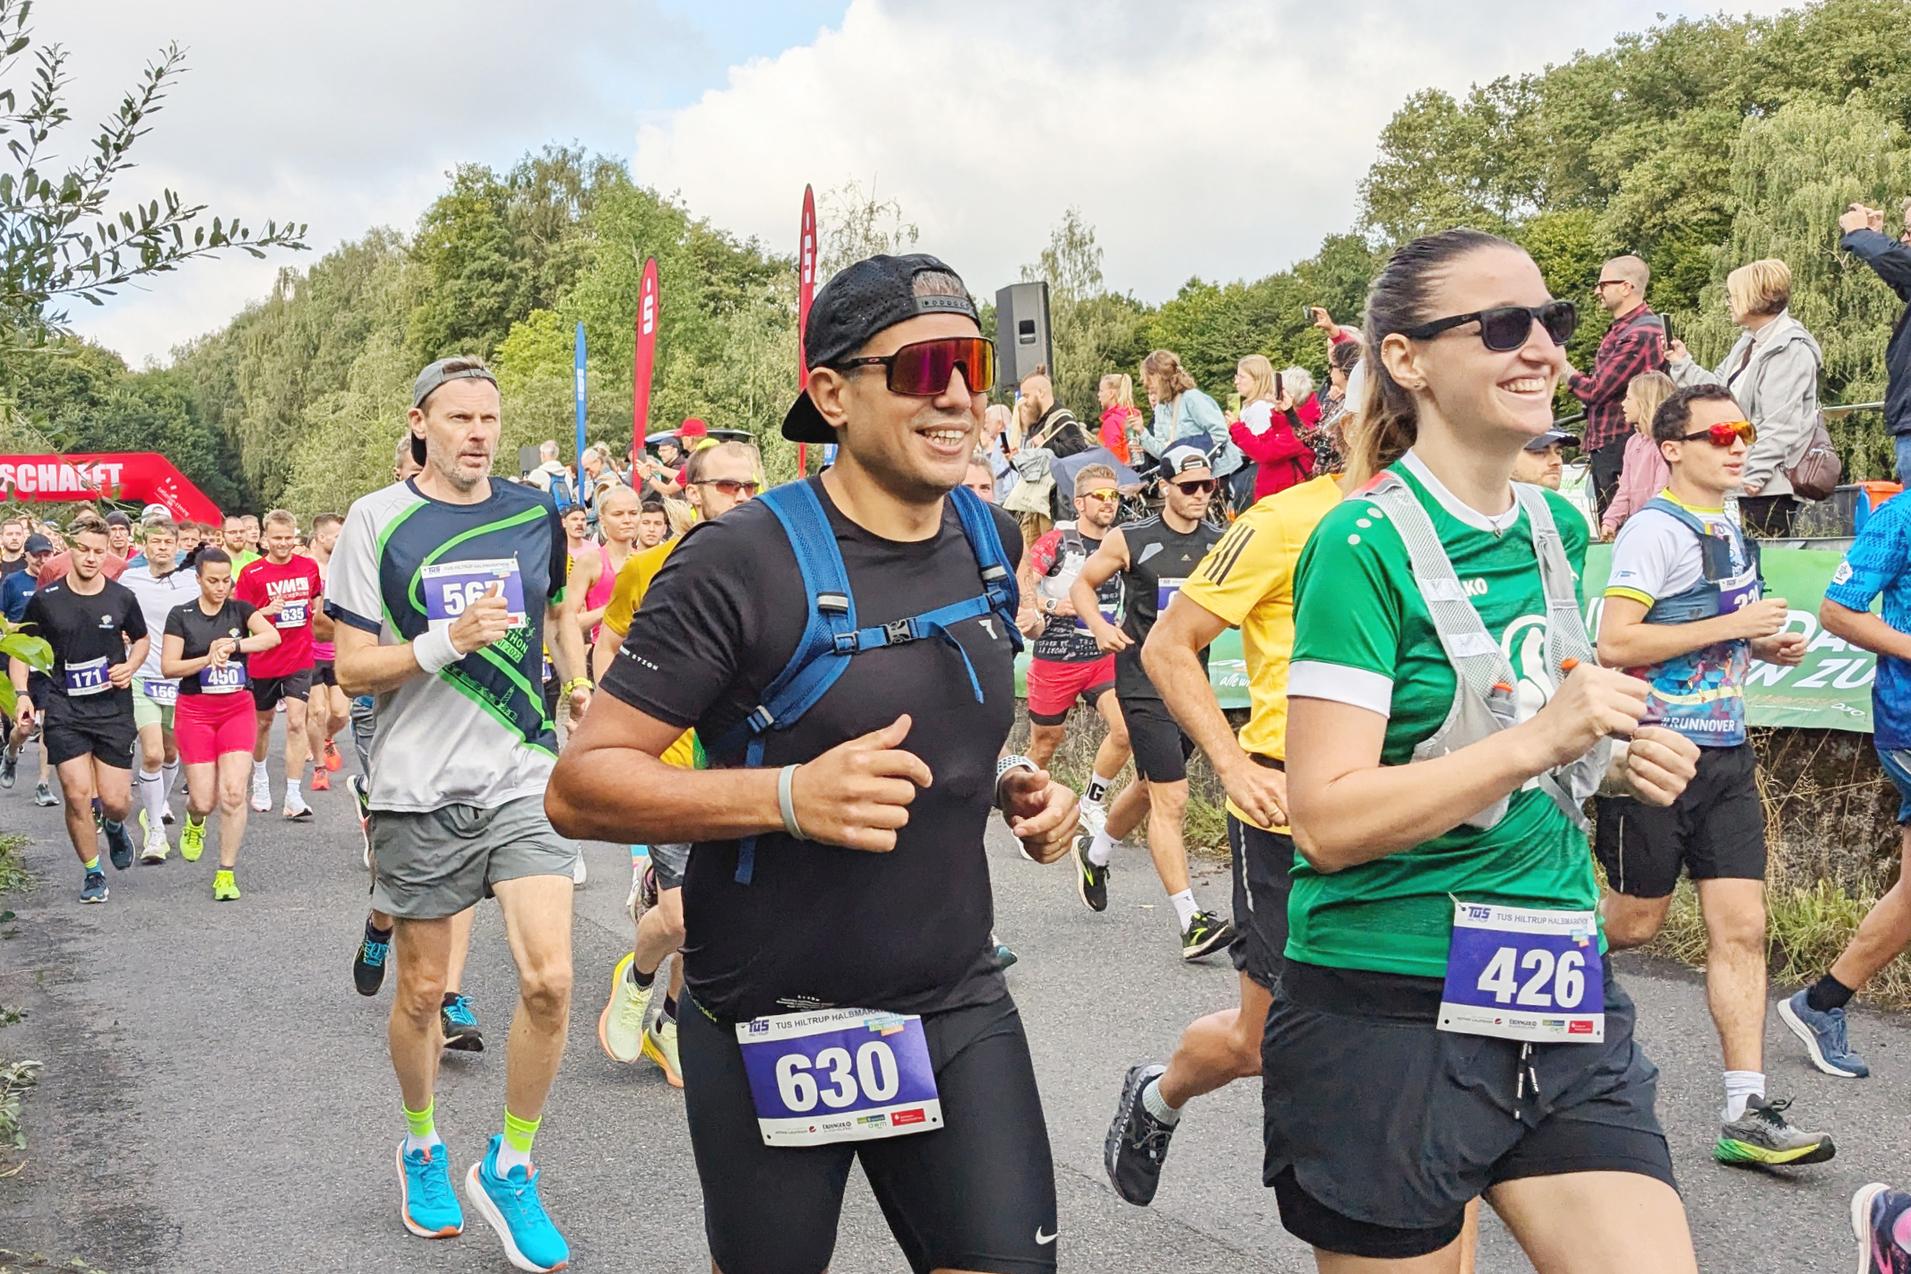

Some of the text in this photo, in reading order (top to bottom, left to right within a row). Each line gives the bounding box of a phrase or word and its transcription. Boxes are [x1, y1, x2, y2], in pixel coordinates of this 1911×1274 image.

[280, 607, 304, 622] 635
[72, 670, 103, 688] 171
[207, 668, 239, 685] 450
[150, 684, 177, 698] 156
[1660, 717, 1735, 732] #RUNNOVER
[1497, 913, 1513, 922] TUS
[1514, 914, 1548, 925] HILTRUP
[1477, 946, 1586, 1009] 426
[775, 1021, 793, 1030] TUS
[794, 1016, 831, 1029] HILTRUP
[775, 1040, 900, 1112] 630
